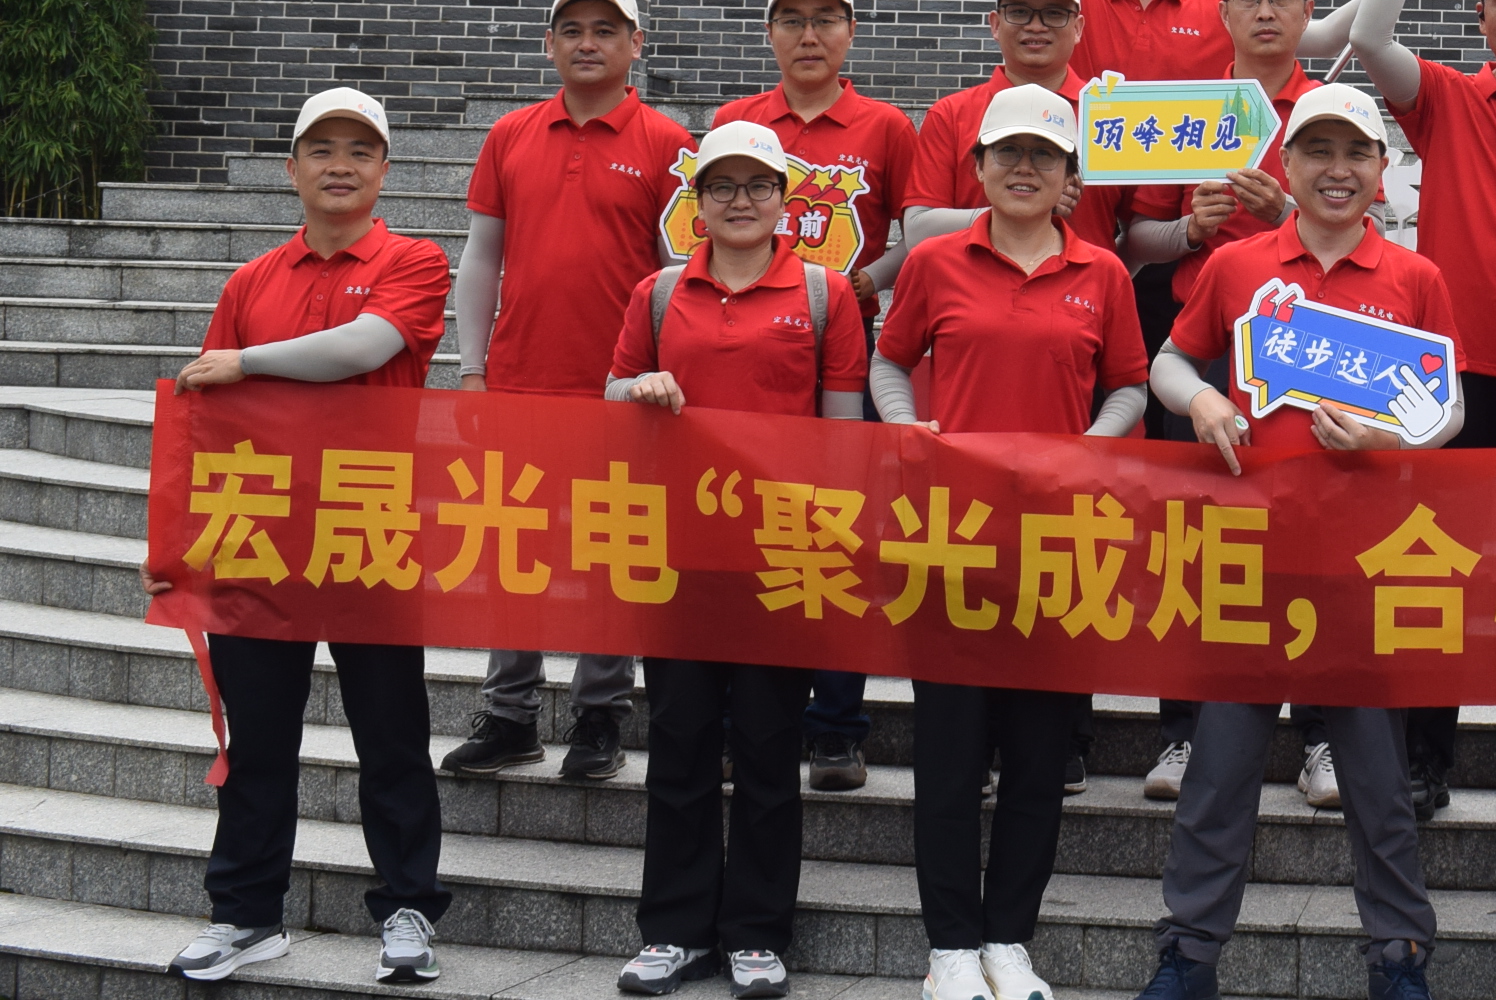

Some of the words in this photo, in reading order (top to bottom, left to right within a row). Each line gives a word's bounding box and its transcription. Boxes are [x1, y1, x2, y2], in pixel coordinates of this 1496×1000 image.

[1092, 114, 1243, 152] 顶峰相见
[1264, 326, 1406, 391] 徒步达人
